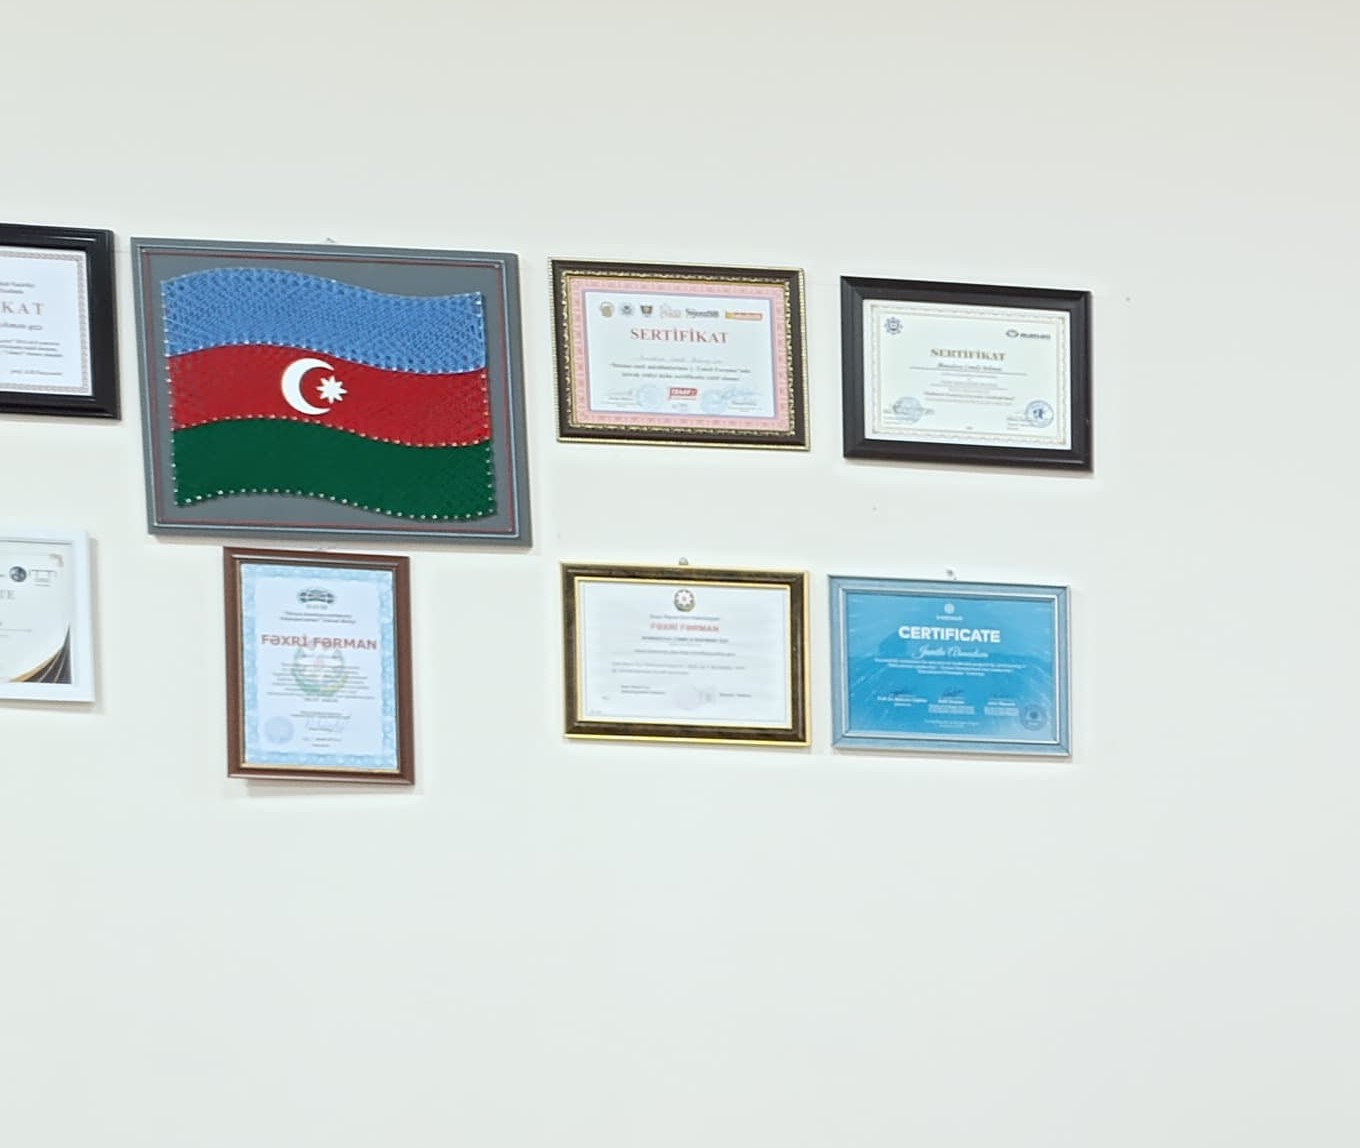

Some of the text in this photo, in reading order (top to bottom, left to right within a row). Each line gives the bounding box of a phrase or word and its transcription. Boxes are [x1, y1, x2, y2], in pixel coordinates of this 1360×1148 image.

[630, 327, 729, 344] SERTİFİKAT
[260, 633, 378, 651] FƏXRİ FƏRMAN
[899, 626, 1001, 643] CERTIFICATE
